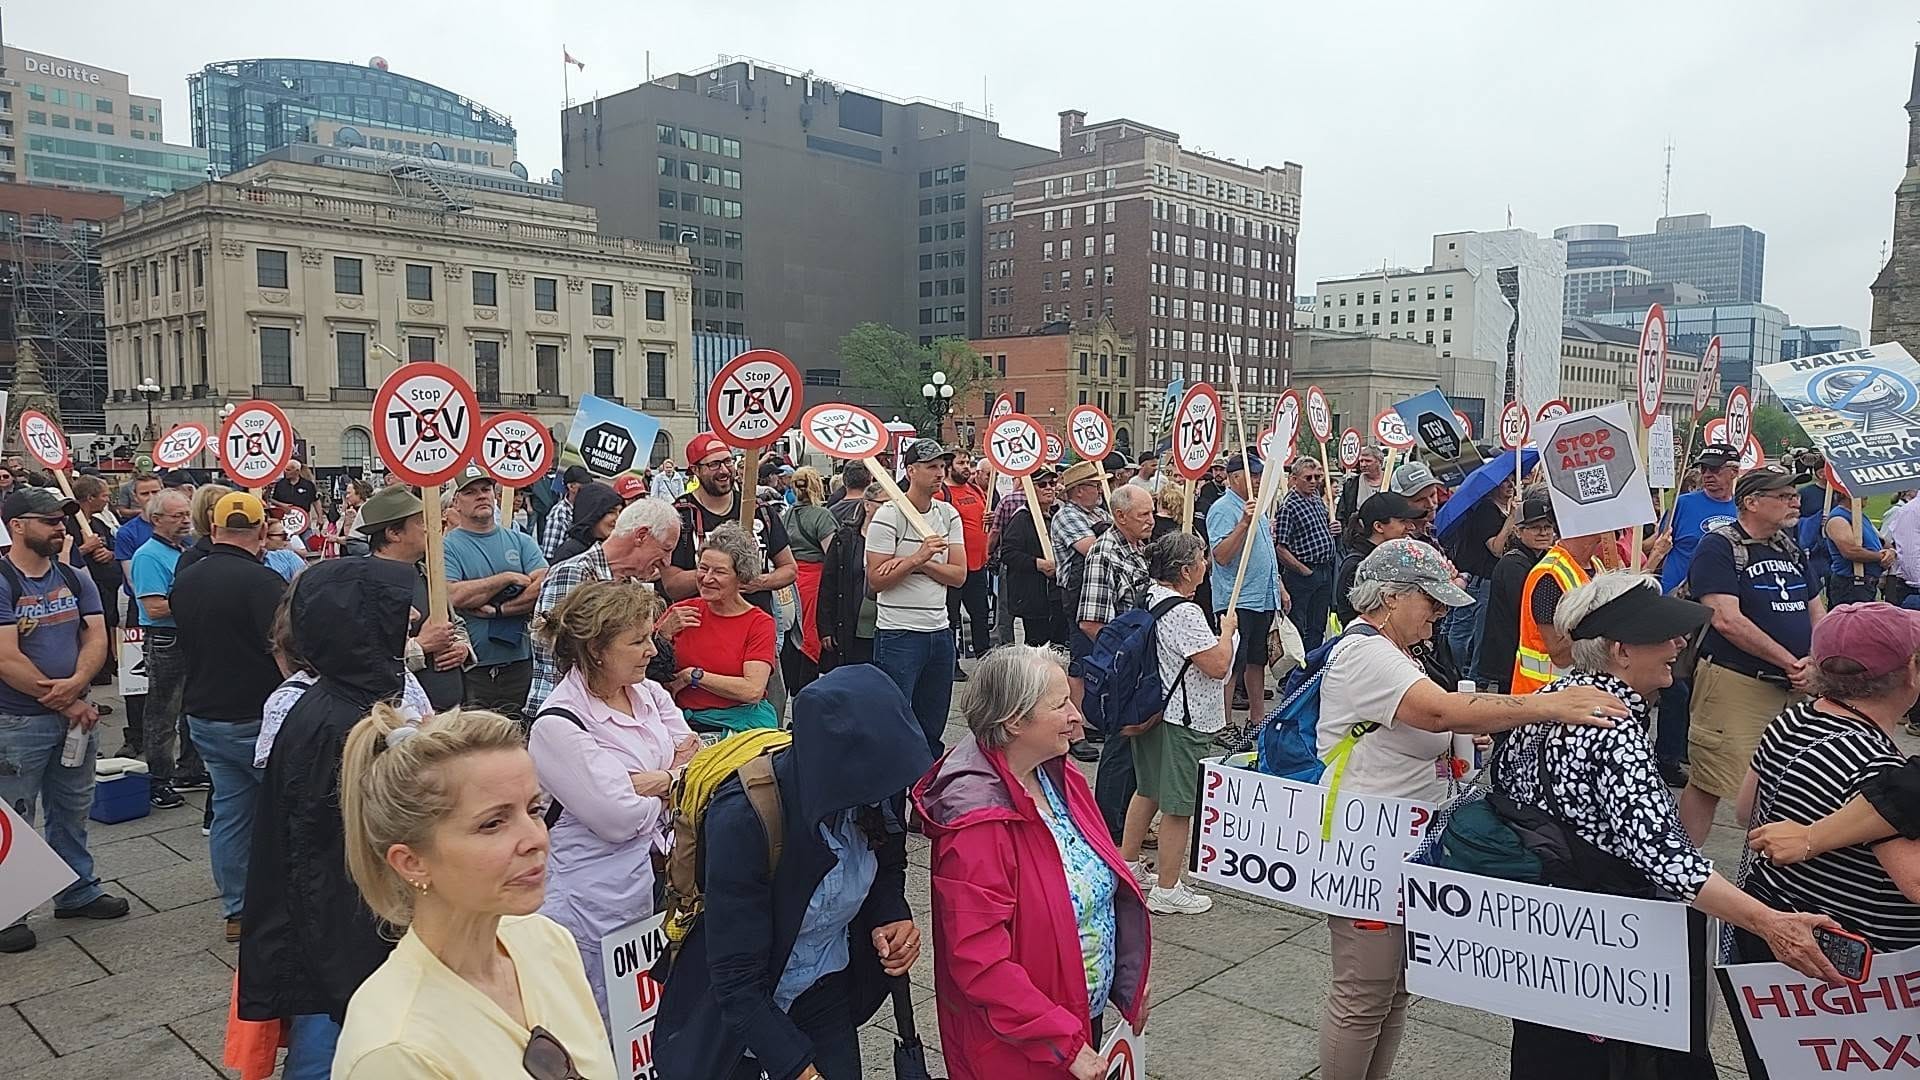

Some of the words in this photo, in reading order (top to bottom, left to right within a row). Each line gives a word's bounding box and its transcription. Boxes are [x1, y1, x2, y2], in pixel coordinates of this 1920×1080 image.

[24, 56, 100, 84] Deloitte
[1790, 348, 1876, 372] HALTE
[744, 371, 771, 383] Stop
[411, 388, 441, 403] Stop
[722, 386, 791, 417] TGV
[823, 413, 846, 424] Stop
[1192, 404, 1206, 414] Stop
[1310, 405, 1328, 423] TGV
[244, 419, 265, 430] Stop
[388, 405, 466, 446] TGV
[738, 418, 769, 430] ALTO
[1079, 416, 1093, 424] Stop
[1278, 410, 1298, 430] TV
[1380, 420, 1412, 435] TG
[1421, 419, 1447, 439] TGV
[1730, 412, 1749, 435] TGV
[28, 431, 59, 449] TGV
[504, 426, 527, 438] Stop
[813, 418, 873, 443] TGV
[1003, 426, 1021, 435] Stop
[1074, 421, 1105, 445] TGV
[1181, 416, 1216, 449] TGV
[164, 435, 201, 454] TGV
[229, 430, 282, 459] TGV
[486, 437, 543, 463] TGV
[597, 430, 629, 455] TGV
[843, 438, 869, 450] ALTO
[992, 432, 1036, 458] TGV
[1047, 443, 1061, 454] GV
[1088, 442, 1102, 451] ALTO
[1342, 442, 1360, 455] TGV
[1555, 428, 1611, 454] STOP
[414, 447, 448, 463] ALTO
[591, 447, 624, 465] MAUVAISE
[1011, 454, 1031, 465] ALTO
[1188, 449, 1205, 461] ALTO
[1560, 446, 1616, 471] ALTO
[243, 460, 267, 471] ALTO
[499, 462, 525, 473] ALTO
[1850, 461, 1914, 484] HALTE
[1746, 560, 1803, 578] TOTTENHA
[16, 595, 78, 618] RANGLE
[1771, 601, 1807, 612] HOTSPUR
[1206, 770, 1223, 799] ?
[1226, 777, 1401, 838] NATION
[1409, 806, 1430, 837] ?
[1203, 805, 1220, 834] ?
[1223, 812, 1377, 872] BUILDING
[1201, 843, 1218, 873] ?
[1220, 848, 1298, 893] 300
[1309, 868, 1383, 912] KM/HR
[1408, 877, 1472, 918] NO
[1478, 890, 1640, 949] APPROVALS
[613, 939, 639, 978] ON
[1407, 930, 1670, 1013] EXPROPRIATIONS!!
[636, 969, 666, 1013] D
[1797, 1034, 1920, 1072] TAX
